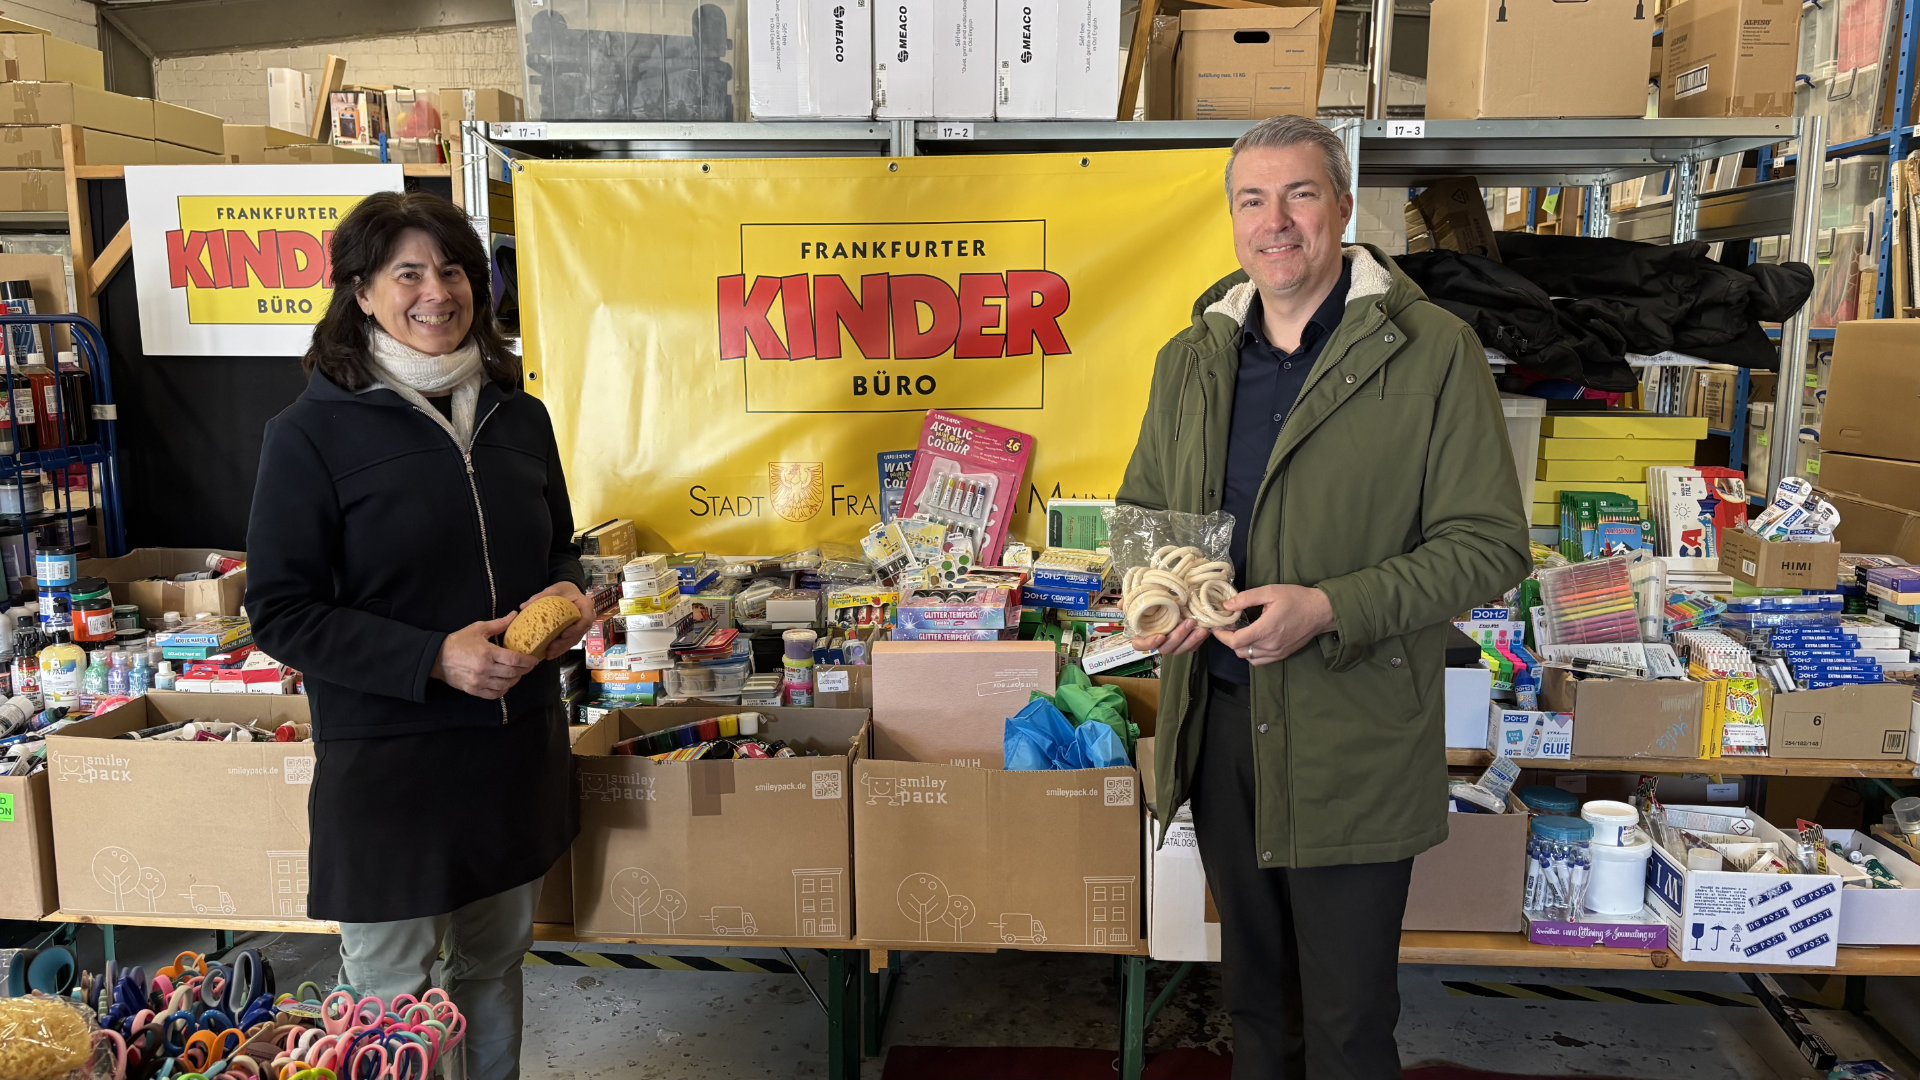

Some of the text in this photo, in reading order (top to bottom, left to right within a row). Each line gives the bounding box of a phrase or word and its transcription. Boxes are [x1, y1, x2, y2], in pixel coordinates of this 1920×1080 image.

[899, 5, 908, 49] MEACO
[1022, 6, 1032, 50] MEACO
[835, 19, 844, 62] MEACO
[217, 207, 338, 220] FRANKFURTER
[801, 239, 987, 260] FRANKFURTER
[258, 296, 313, 314] BÜRO
[717, 269, 1072, 361] KINDER
[853, 370, 937, 397] BÜRO
[930, 421, 973, 441] ACRYLIC
[927, 436, 971, 456] COLOUR
[1006, 439, 1021, 451] 16
[1781, 482, 1799, 493] DOMS
[689, 485, 765, 518] STADT
[1784, 508, 1803, 527] DOMS
[1781, 561, 1812, 571] HIMI
[1036, 571, 1061, 580] DOMS
[1024, 592, 1049, 600] DOMS
[924, 610, 978, 620] GLITTER TEMPERA
[1473, 609, 1507, 619] DOMS
[215, 635, 250, 652] GOUACHE PAINT
[918, 633, 972, 641] GLITTER TEMPERA
[1088, 656, 1115, 670] Babykit
[1504, 715, 1529, 723] DOMS
[1813, 715, 1822, 726] 6
[1543, 743, 1570, 754] GLUE
[87, 754, 130, 768] smiley
[950, 758, 981, 768] HIMI
[88, 769, 132, 784] pack
[227, 766, 279, 776] smileypack.de
[611, 773, 656, 788] smiley
[755, 782, 807, 793] smileypack.de
[900, 776, 947, 792] smiley
[611, 789, 657, 802] pack
[900, 790, 948, 806] pack
[1046, 787, 1098, 799] smileypack.de
[1800, 825, 1825, 845] E6000
[1794, 884, 1835, 907] DE POST
[1748, 908, 1789, 931] DE POST
[1791, 909, 1832, 932] DE POST
[1578, 926, 1604, 940] Lettering
[1611, 926, 1648, 942] Journaling
[1745, 933, 1786, 957] DE POST
[1788, 934, 1829, 958] DE POST
